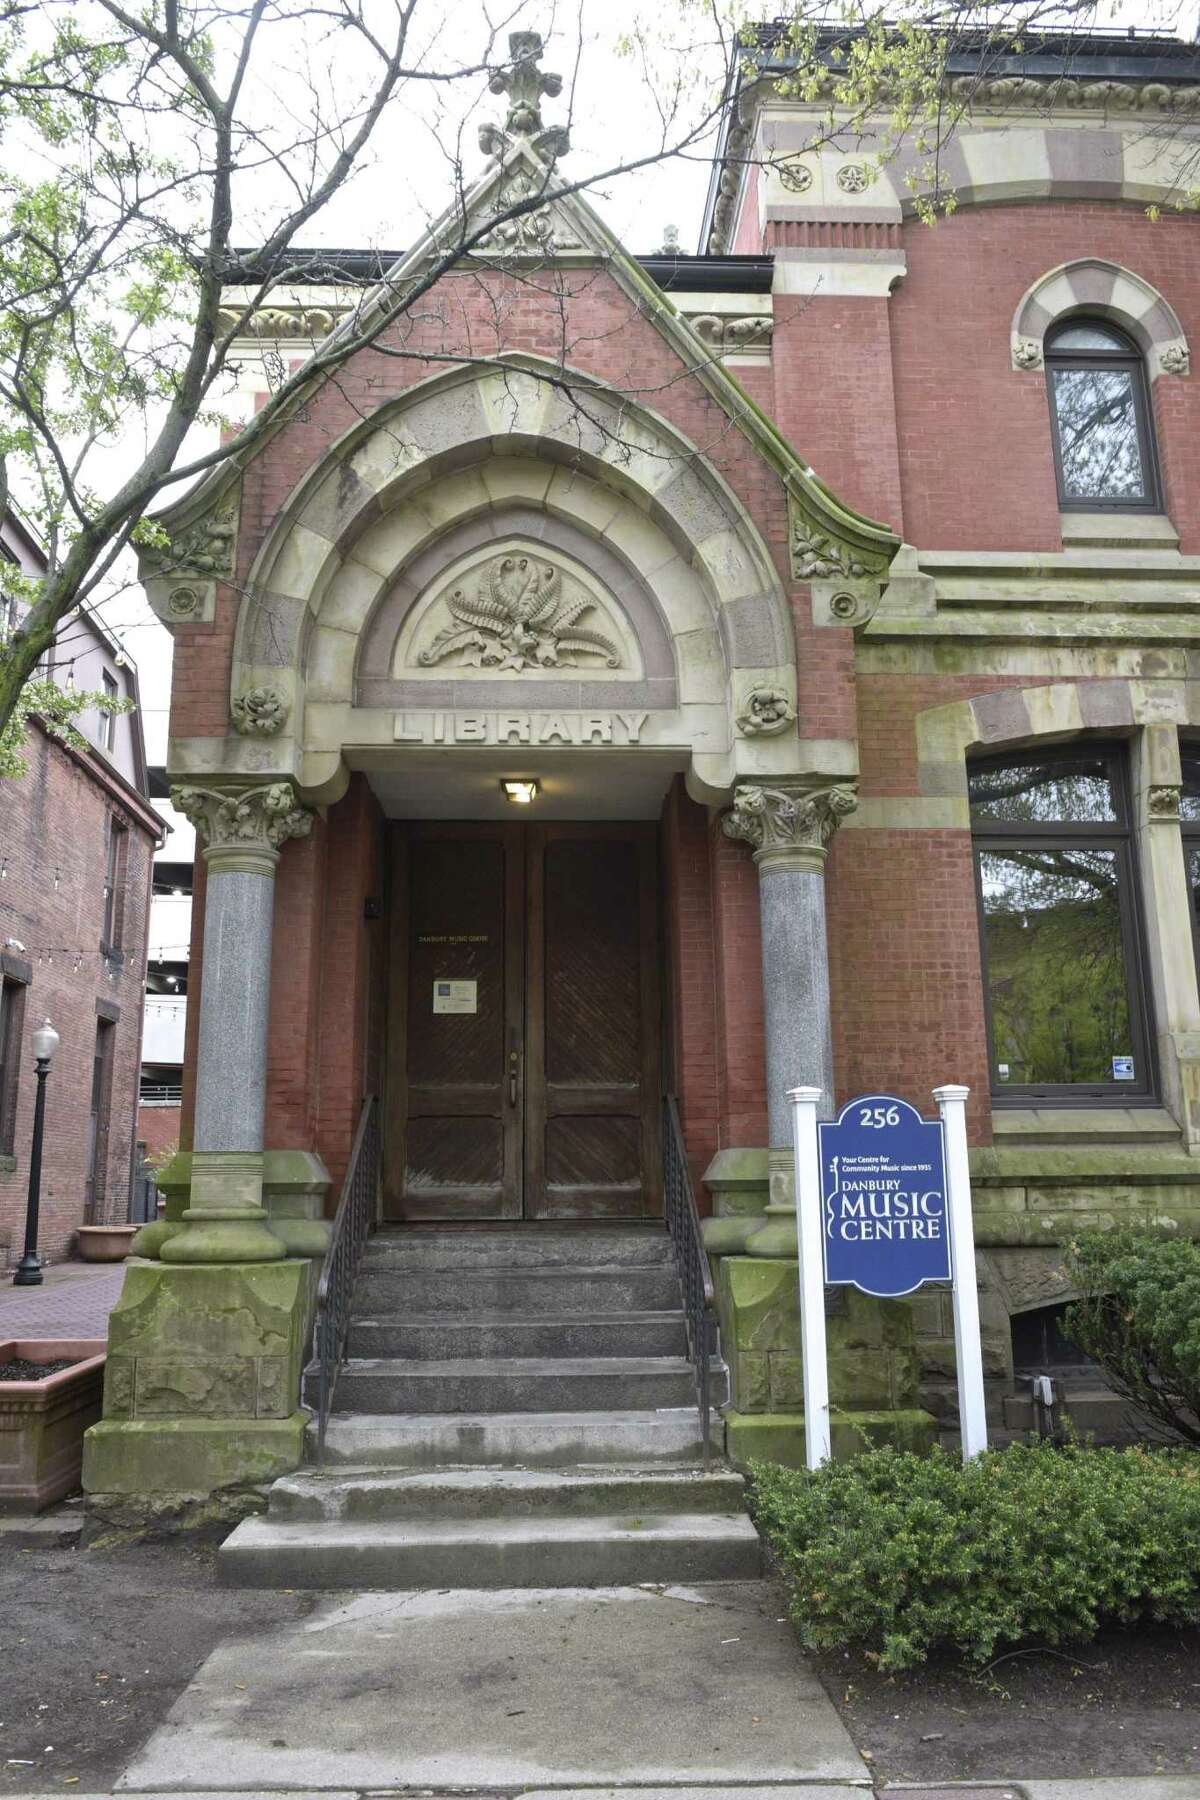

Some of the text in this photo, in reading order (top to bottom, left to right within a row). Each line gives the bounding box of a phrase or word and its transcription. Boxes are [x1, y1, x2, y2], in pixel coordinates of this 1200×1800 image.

[393, 713, 649, 743] LIBRARY
[860, 1106, 900, 1128] 256
[842, 1155, 890, 1164] Your Centre for
[842, 1165, 880, 1173] Community
[881, 1164, 899, 1172] Music
[842, 1180, 901, 1191] DANBURY
[840, 1191, 942, 1218] MUSIC
[840, 1219, 941, 1241] CENTRE
